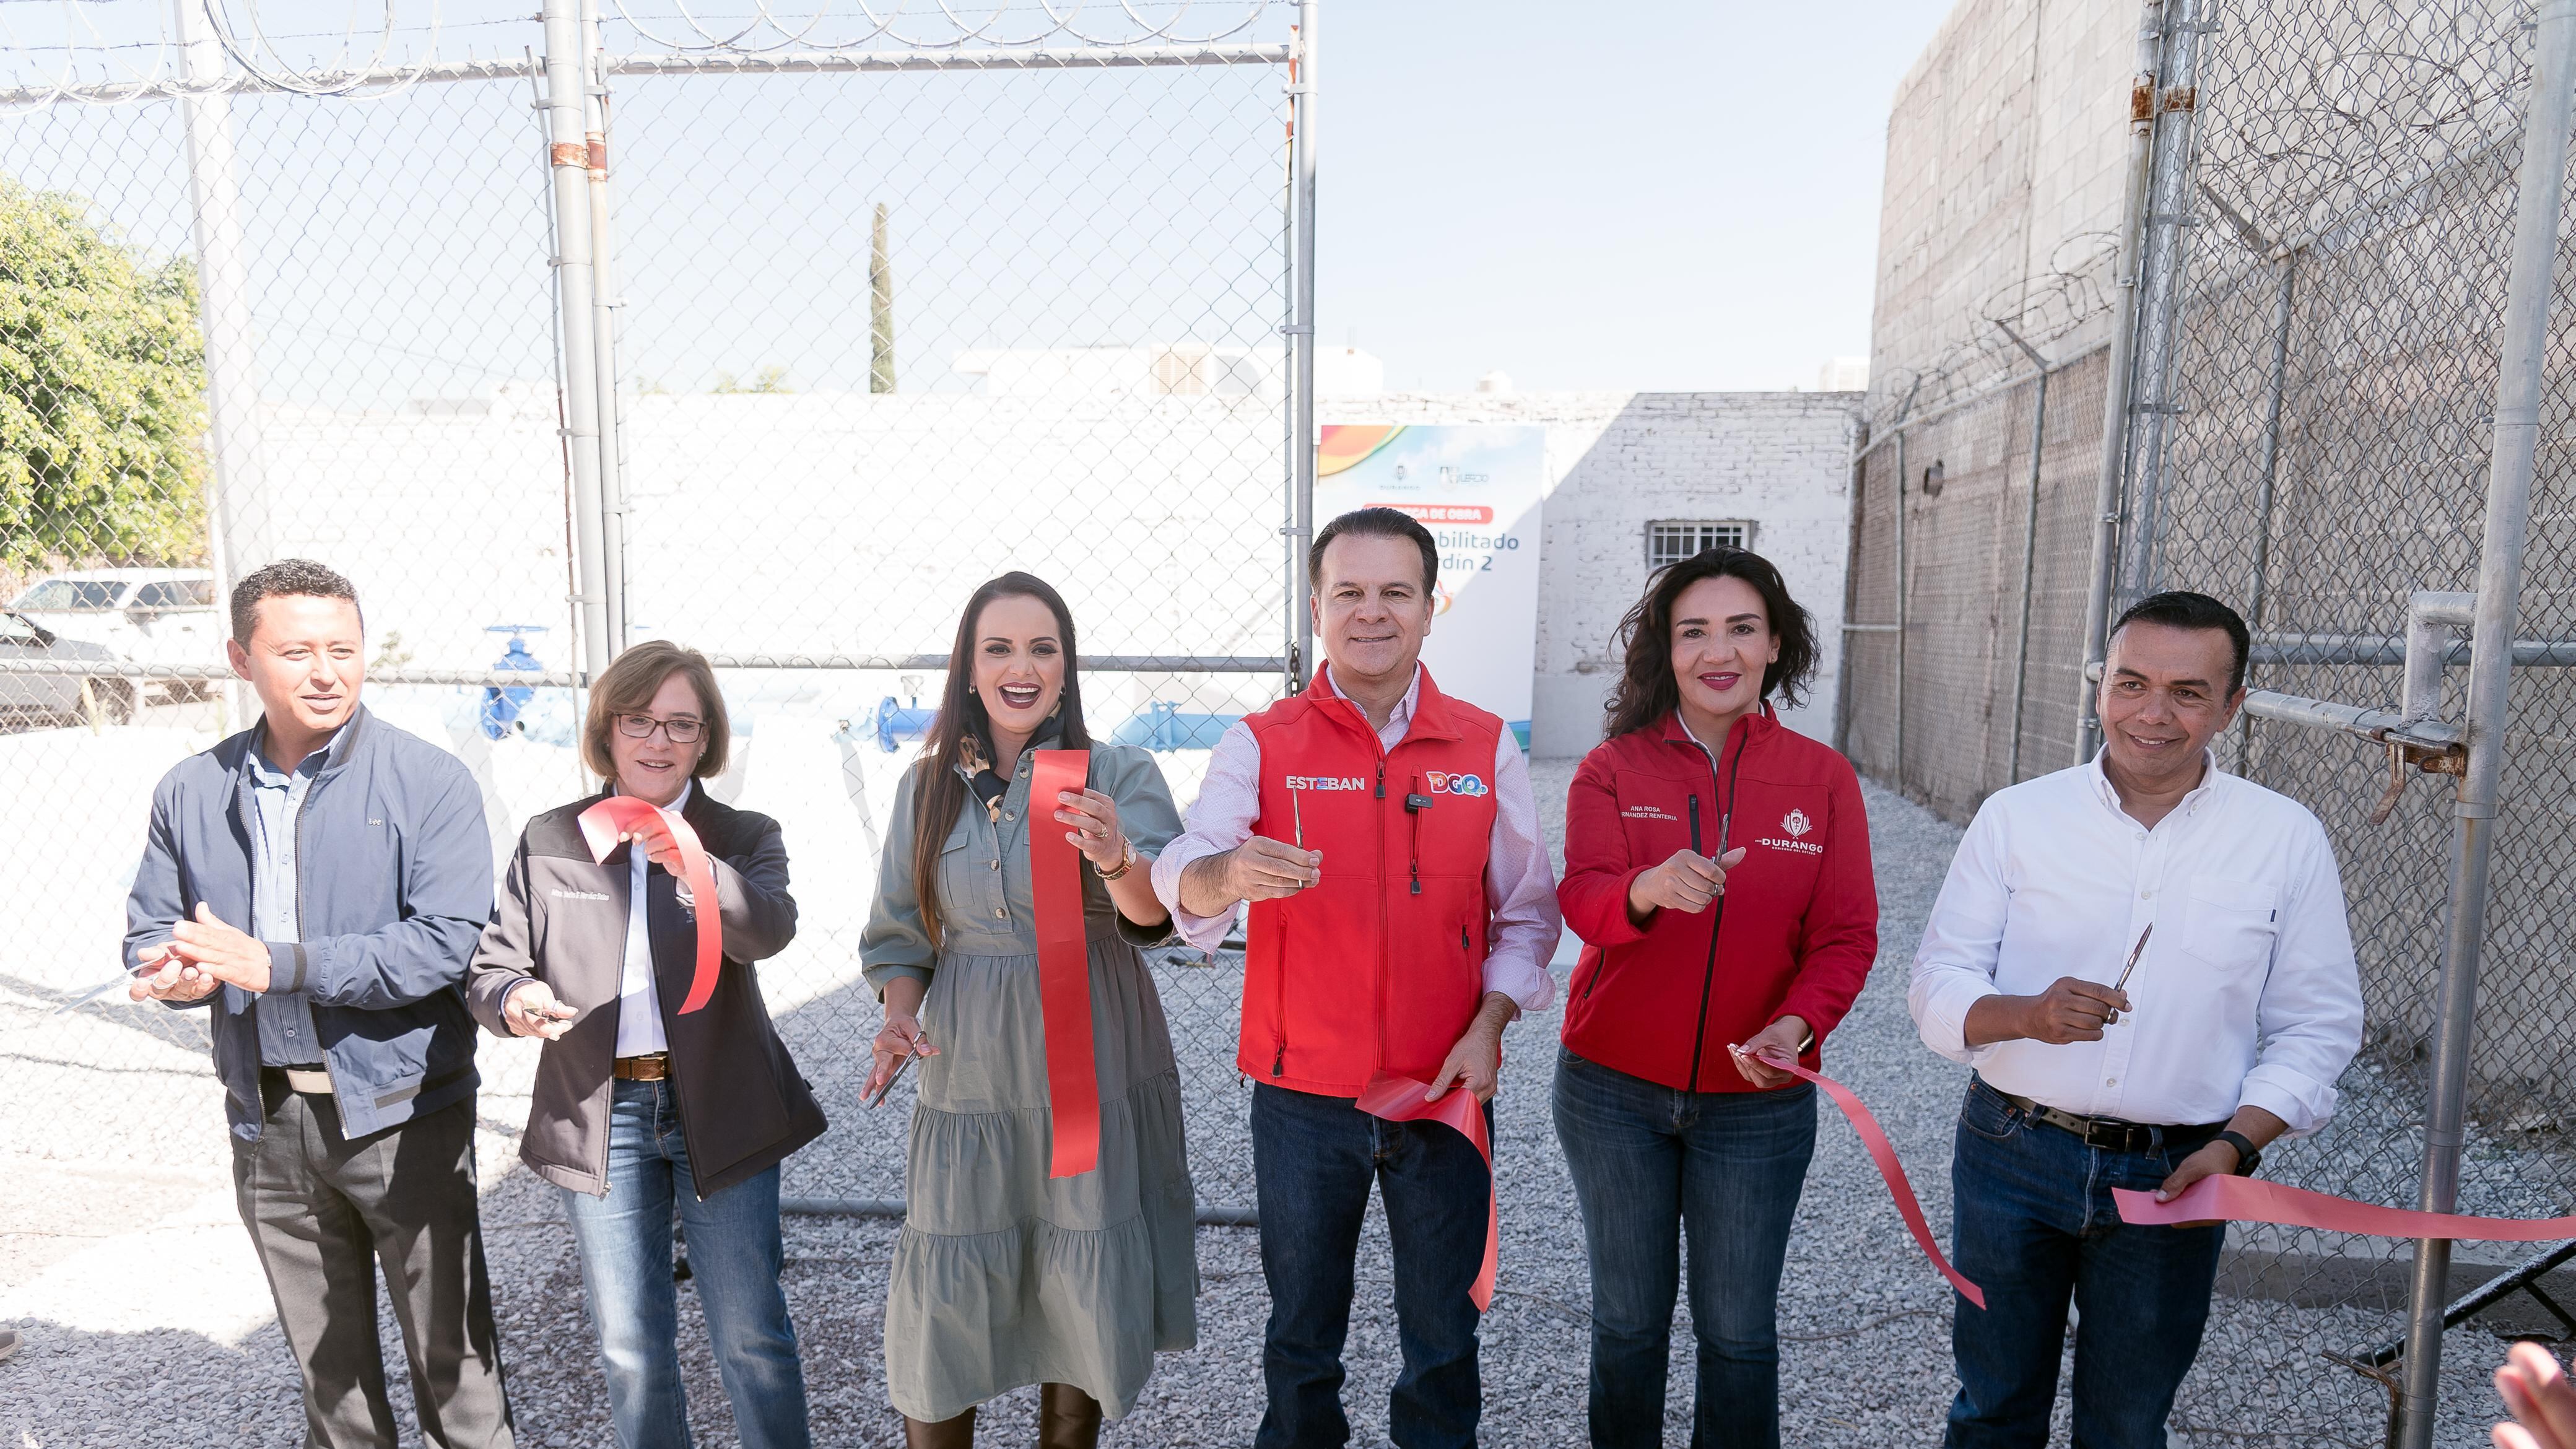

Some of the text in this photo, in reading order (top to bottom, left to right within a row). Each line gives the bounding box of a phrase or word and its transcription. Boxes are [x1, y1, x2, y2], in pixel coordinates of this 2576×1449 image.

[1429, 508, 1447, 520] DE
[1447, 508, 1482, 521] OBRA
[1434, 531, 1519, 549] bilitado
[1438, 554, 1492, 570] din 2
[1286, 775, 1365, 791] ESTEBAN
[1649, 813, 1677, 821] RENTERIA
[1762, 838, 1823, 853] DURANGO
